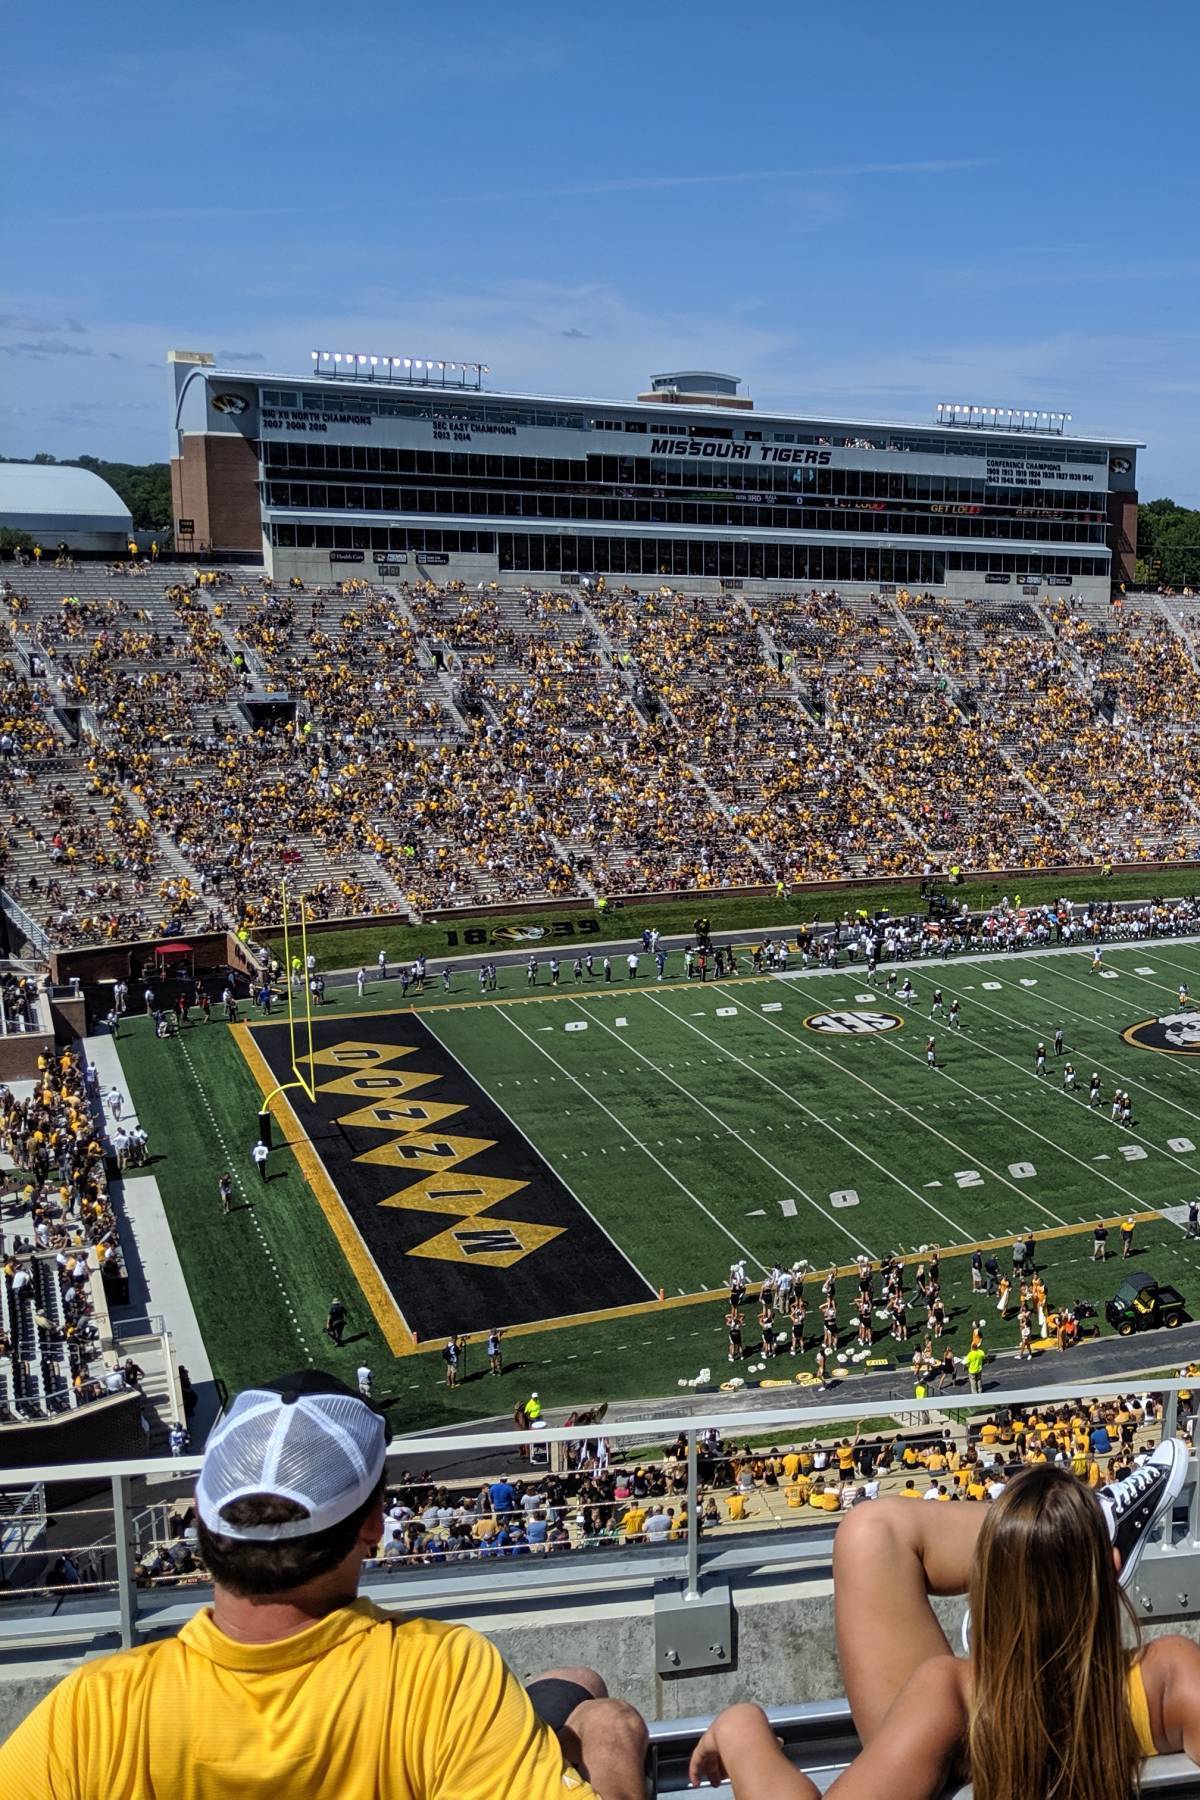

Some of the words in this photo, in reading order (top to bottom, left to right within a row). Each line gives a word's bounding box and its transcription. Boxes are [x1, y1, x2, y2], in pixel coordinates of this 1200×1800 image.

[292, 411, 320, 421] NORTH
[322, 413, 372, 425] CHAMPIONS
[263, 420, 283, 429] 2007
[286, 421, 306, 431] 2008
[309, 422, 328, 432] 2010
[433, 421, 448, 431] SEC
[449, 422, 469, 432] EAST
[470, 423, 517, 435] CHAMPIONS
[433, 430, 451, 440] 2013
[453, 432, 472, 441] 2014
[650, 438, 752, 460] MISSOURI
[760, 446, 832, 465] TIGERS
[986, 459, 1025, 469] CONFERENCE
[1025, 462, 1062, 471] CHAMPIONS
[930, 504, 950, 513] GET
[552, 919, 601, 937] 39
[330, 1048, 526, 1258] MIZZOU
